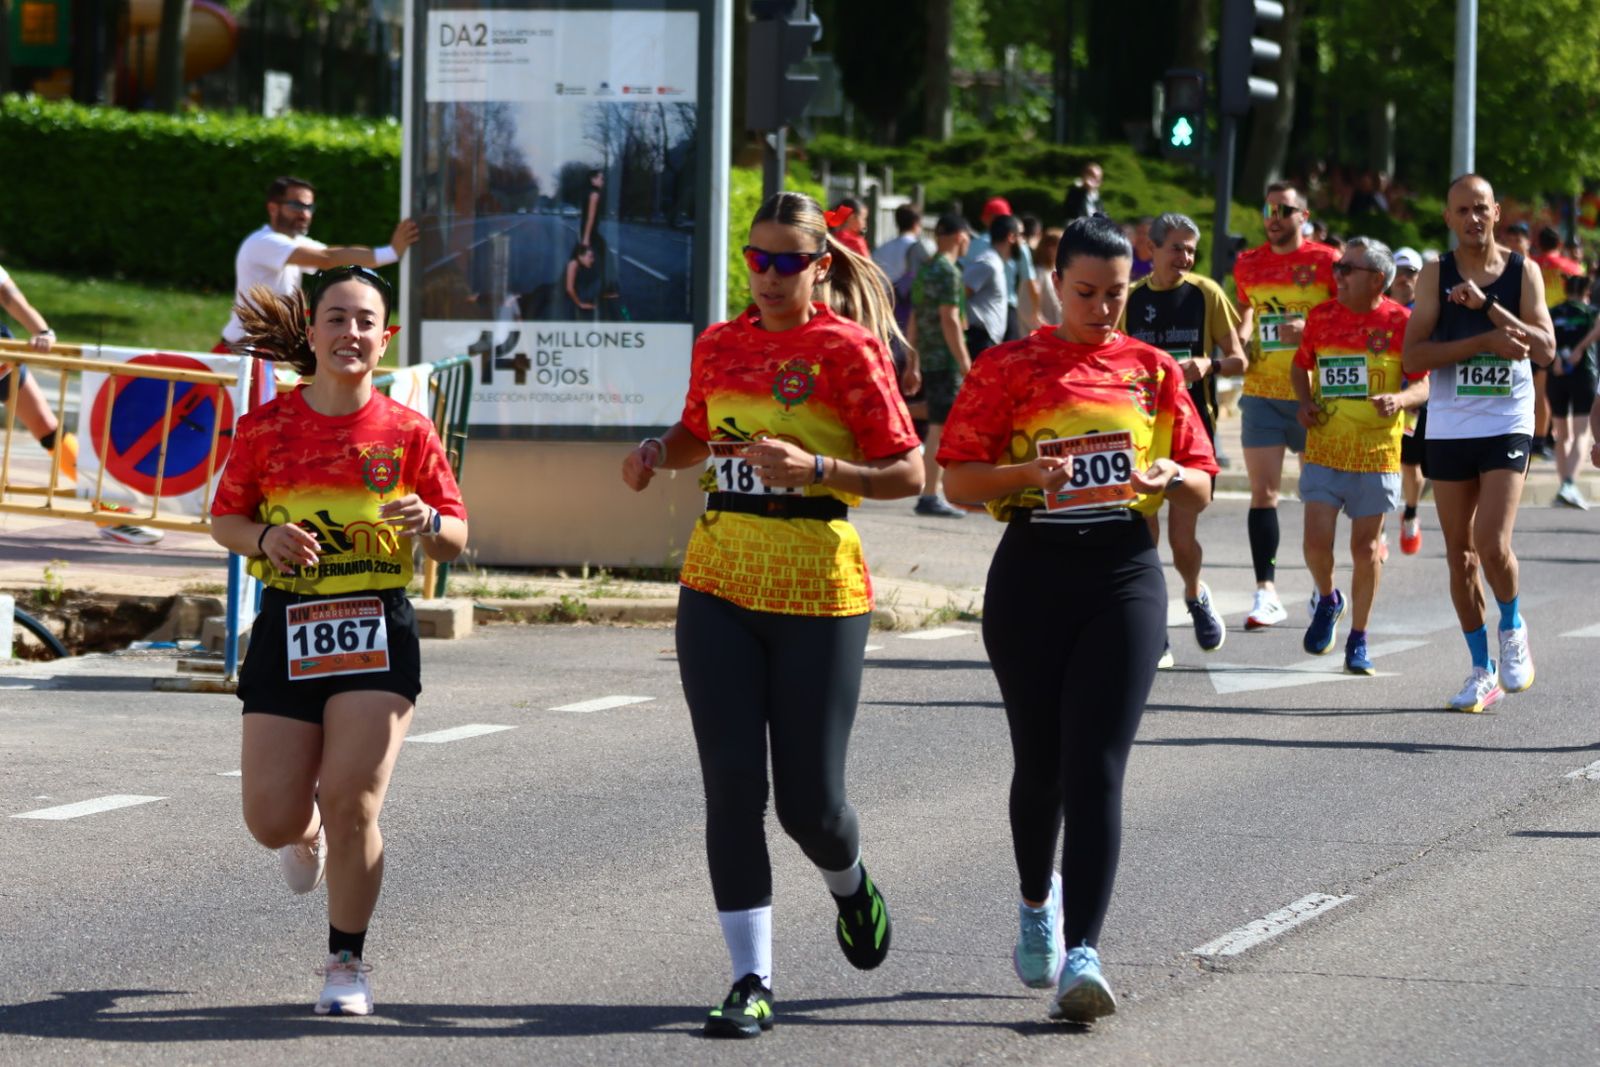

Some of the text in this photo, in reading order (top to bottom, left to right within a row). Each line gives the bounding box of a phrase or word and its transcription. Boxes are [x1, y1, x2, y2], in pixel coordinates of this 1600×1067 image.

[440, 23, 487, 47] DA2
[536, 331, 645, 349] MILLONES
[468, 330, 532, 385] 14
[536, 350, 563, 367] DE
[536, 368, 589, 387] OJOS
[1325, 367, 1360, 385] 655
[1458, 367, 1510, 385] 1642
[319, 559, 373, 577] FERNANDO
[312, 608, 357, 619] CARRERA
[292, 618, 381, 657] 1867
